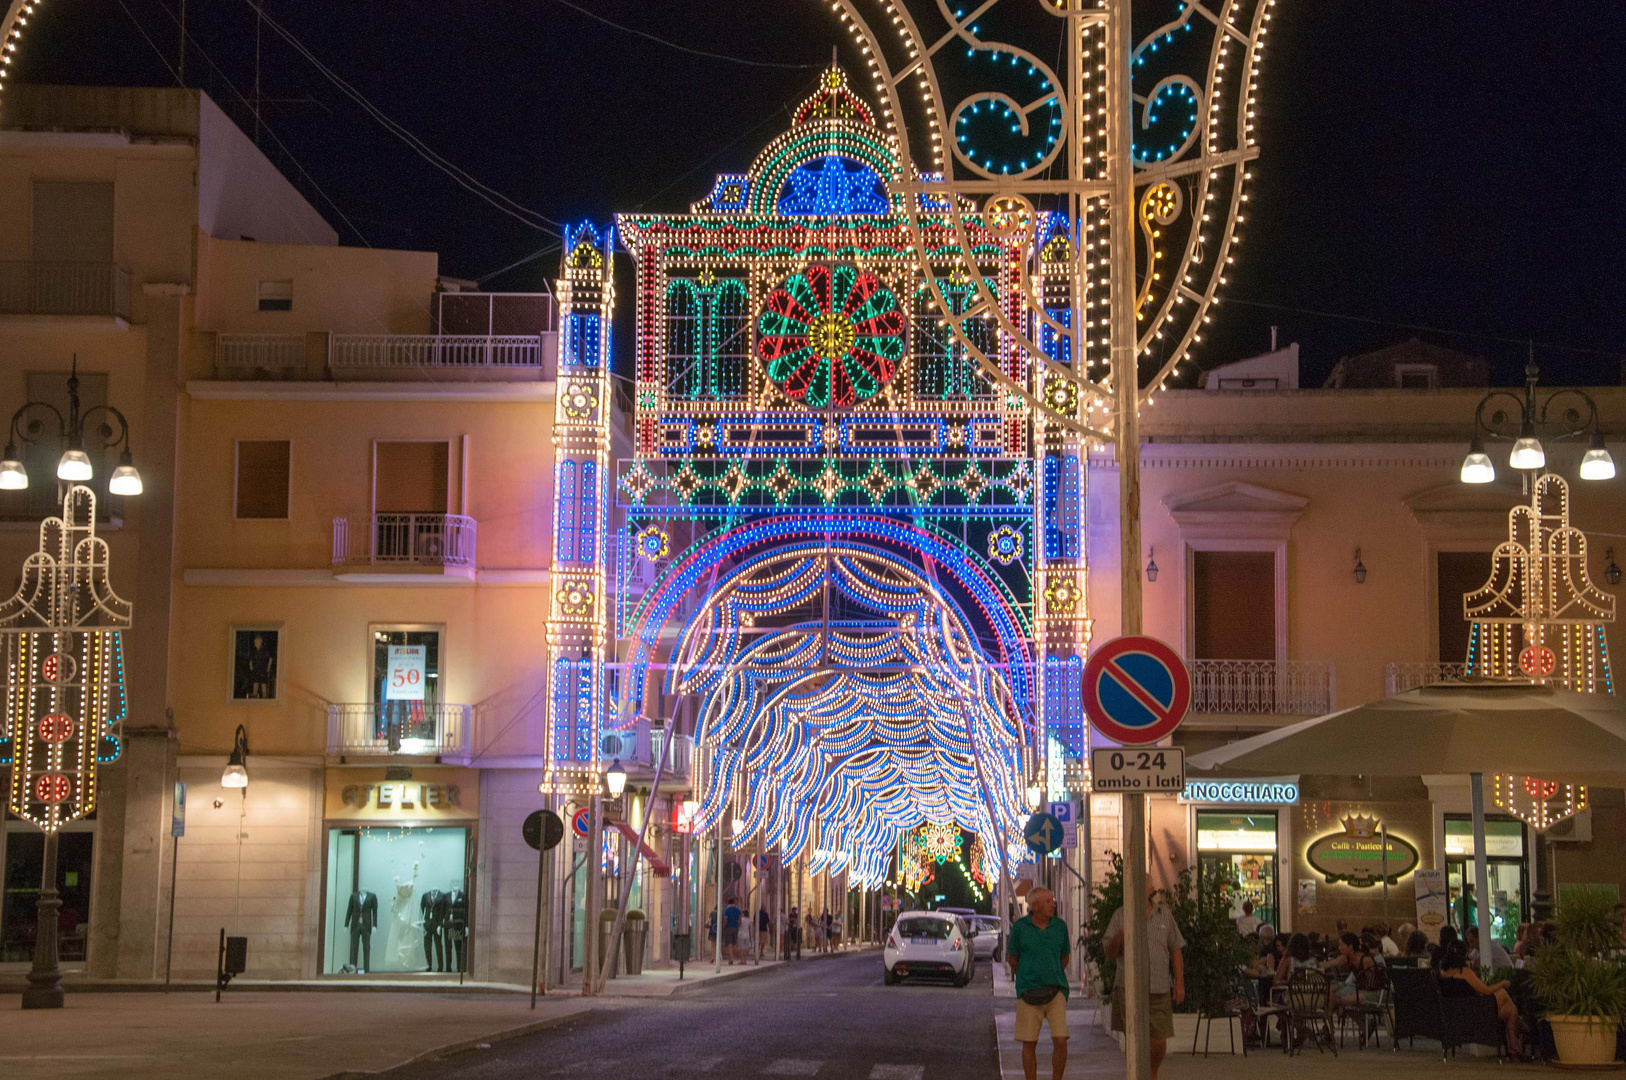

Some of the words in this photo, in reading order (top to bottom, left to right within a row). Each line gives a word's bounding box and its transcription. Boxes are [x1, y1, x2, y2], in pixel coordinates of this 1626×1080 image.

[392, 668, 420, 687] 50
[1110, 752, 1167, 771] 0-24
[1097, 774, 1141, 788] ambo
[1146, 775, 1151, 788] i
[1156, 774, 1180, 788] lati
[341, 783, 461, 805] ATELIER
[1054, 804, 1067, 819] P
[1356, 842, 1393, 850] Pasticceia
